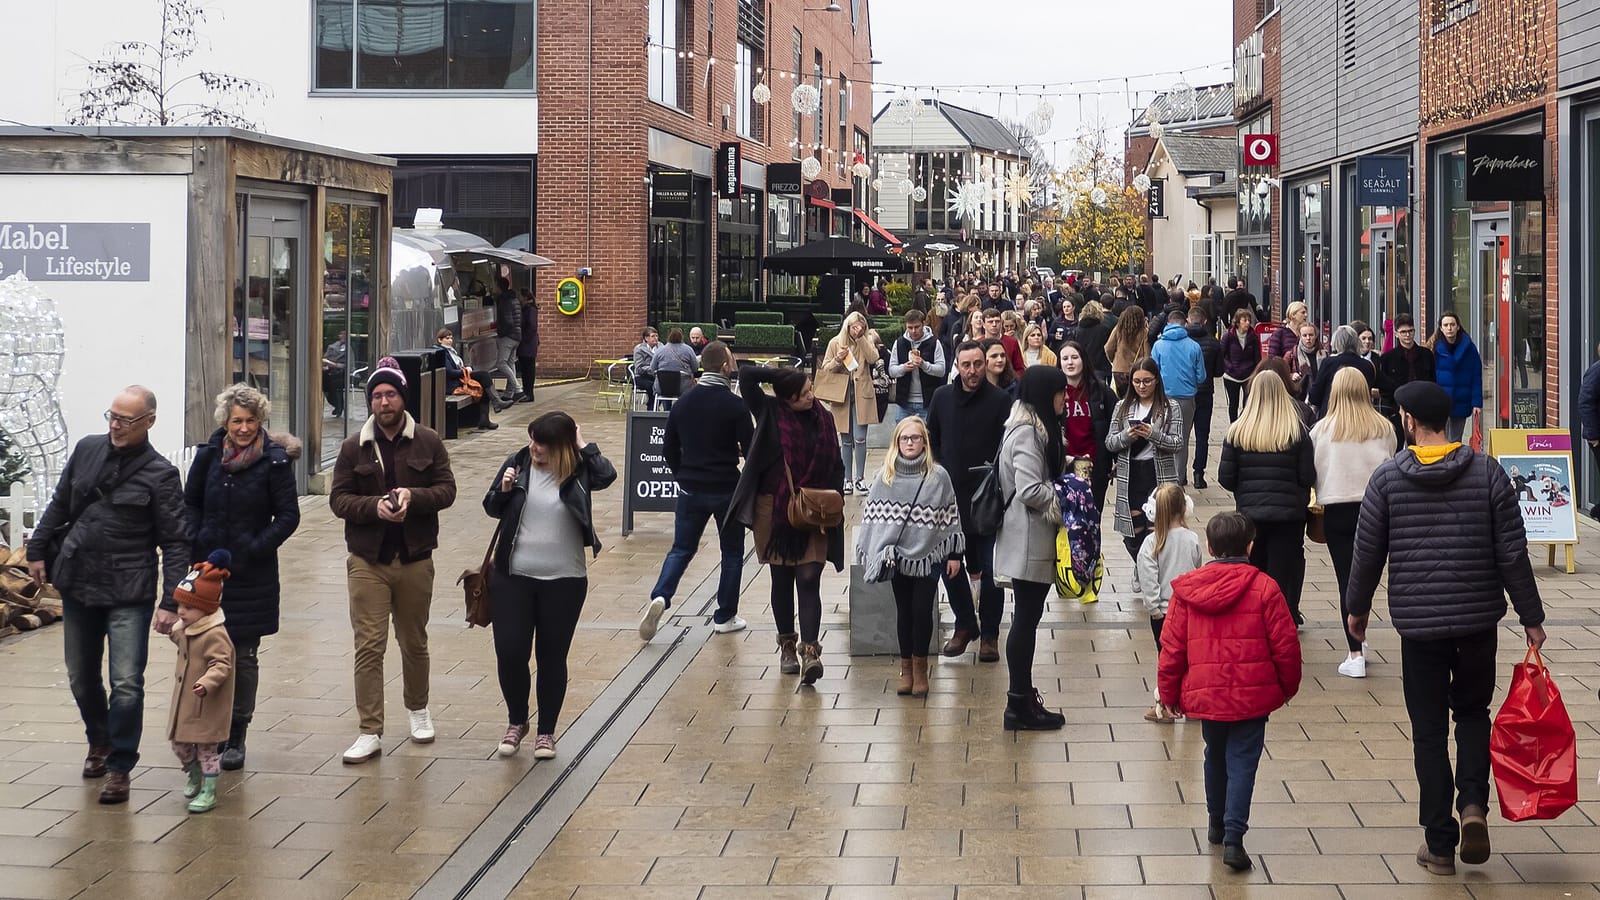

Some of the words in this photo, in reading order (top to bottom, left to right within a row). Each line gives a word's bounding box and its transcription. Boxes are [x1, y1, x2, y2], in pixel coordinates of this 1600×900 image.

[728, 146, 736, 194] wagamama
[771, 183, 800, 192] PREZZO
[1363, 179, 1401, 188] SEASALT
[46, 256, 131, 279] Lifestyle
[640, 453, 662, 461] Come
[1524, 506, 1552, 516] WIN
